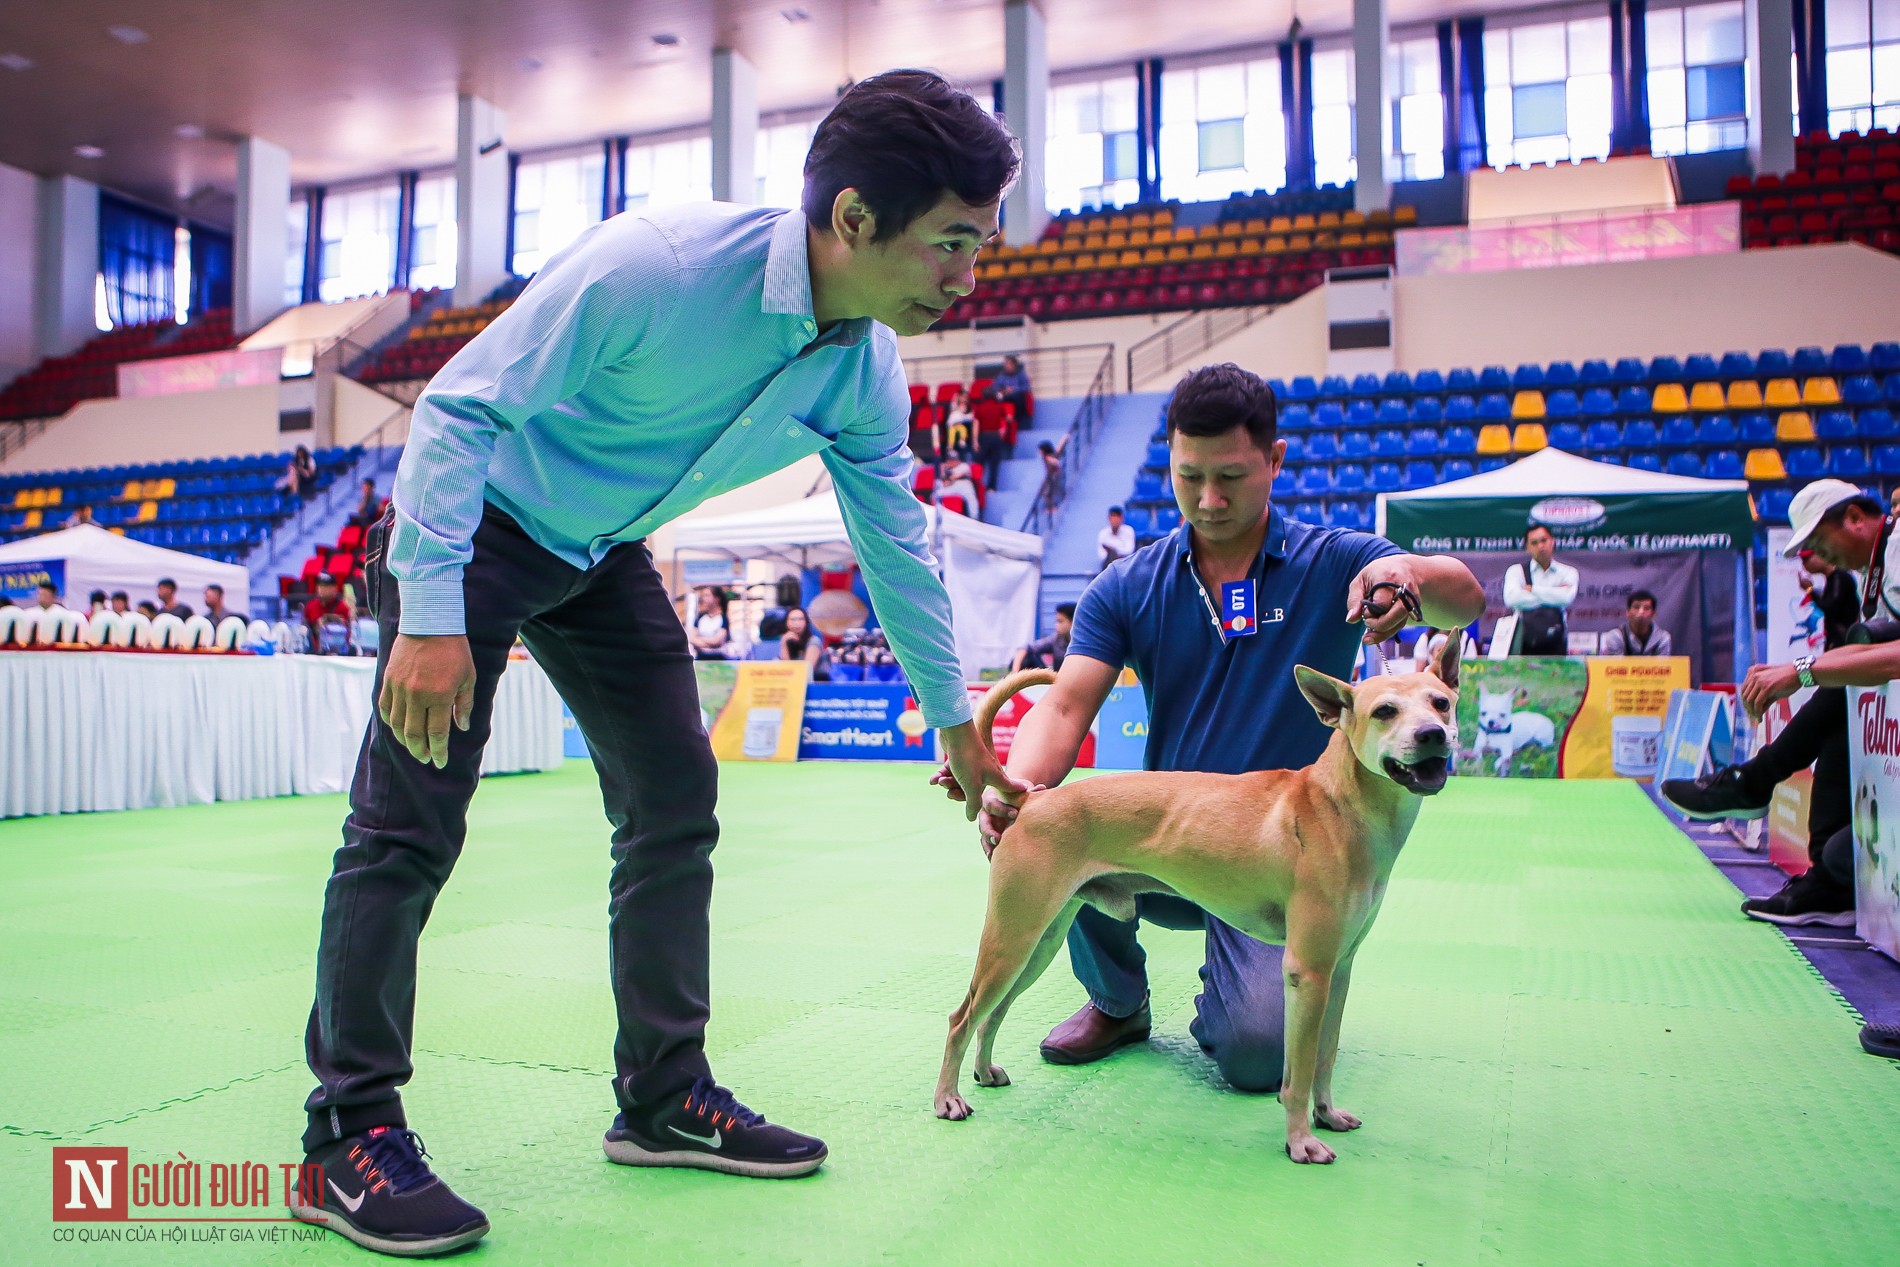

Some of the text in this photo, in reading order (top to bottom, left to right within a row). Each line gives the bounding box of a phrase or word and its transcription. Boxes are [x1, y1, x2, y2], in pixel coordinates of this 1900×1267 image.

[1413, 534, 1452, 550] CÔNG
[1456, 536, 1471, 550] TY
[1587, 531, 1629, 551] QUỐC
[1651, 533, 1731, 550] (VIPHAVET)
[1231, 588, 1245, 611] 071
[802, 727, 894, 746] SmartHeart
